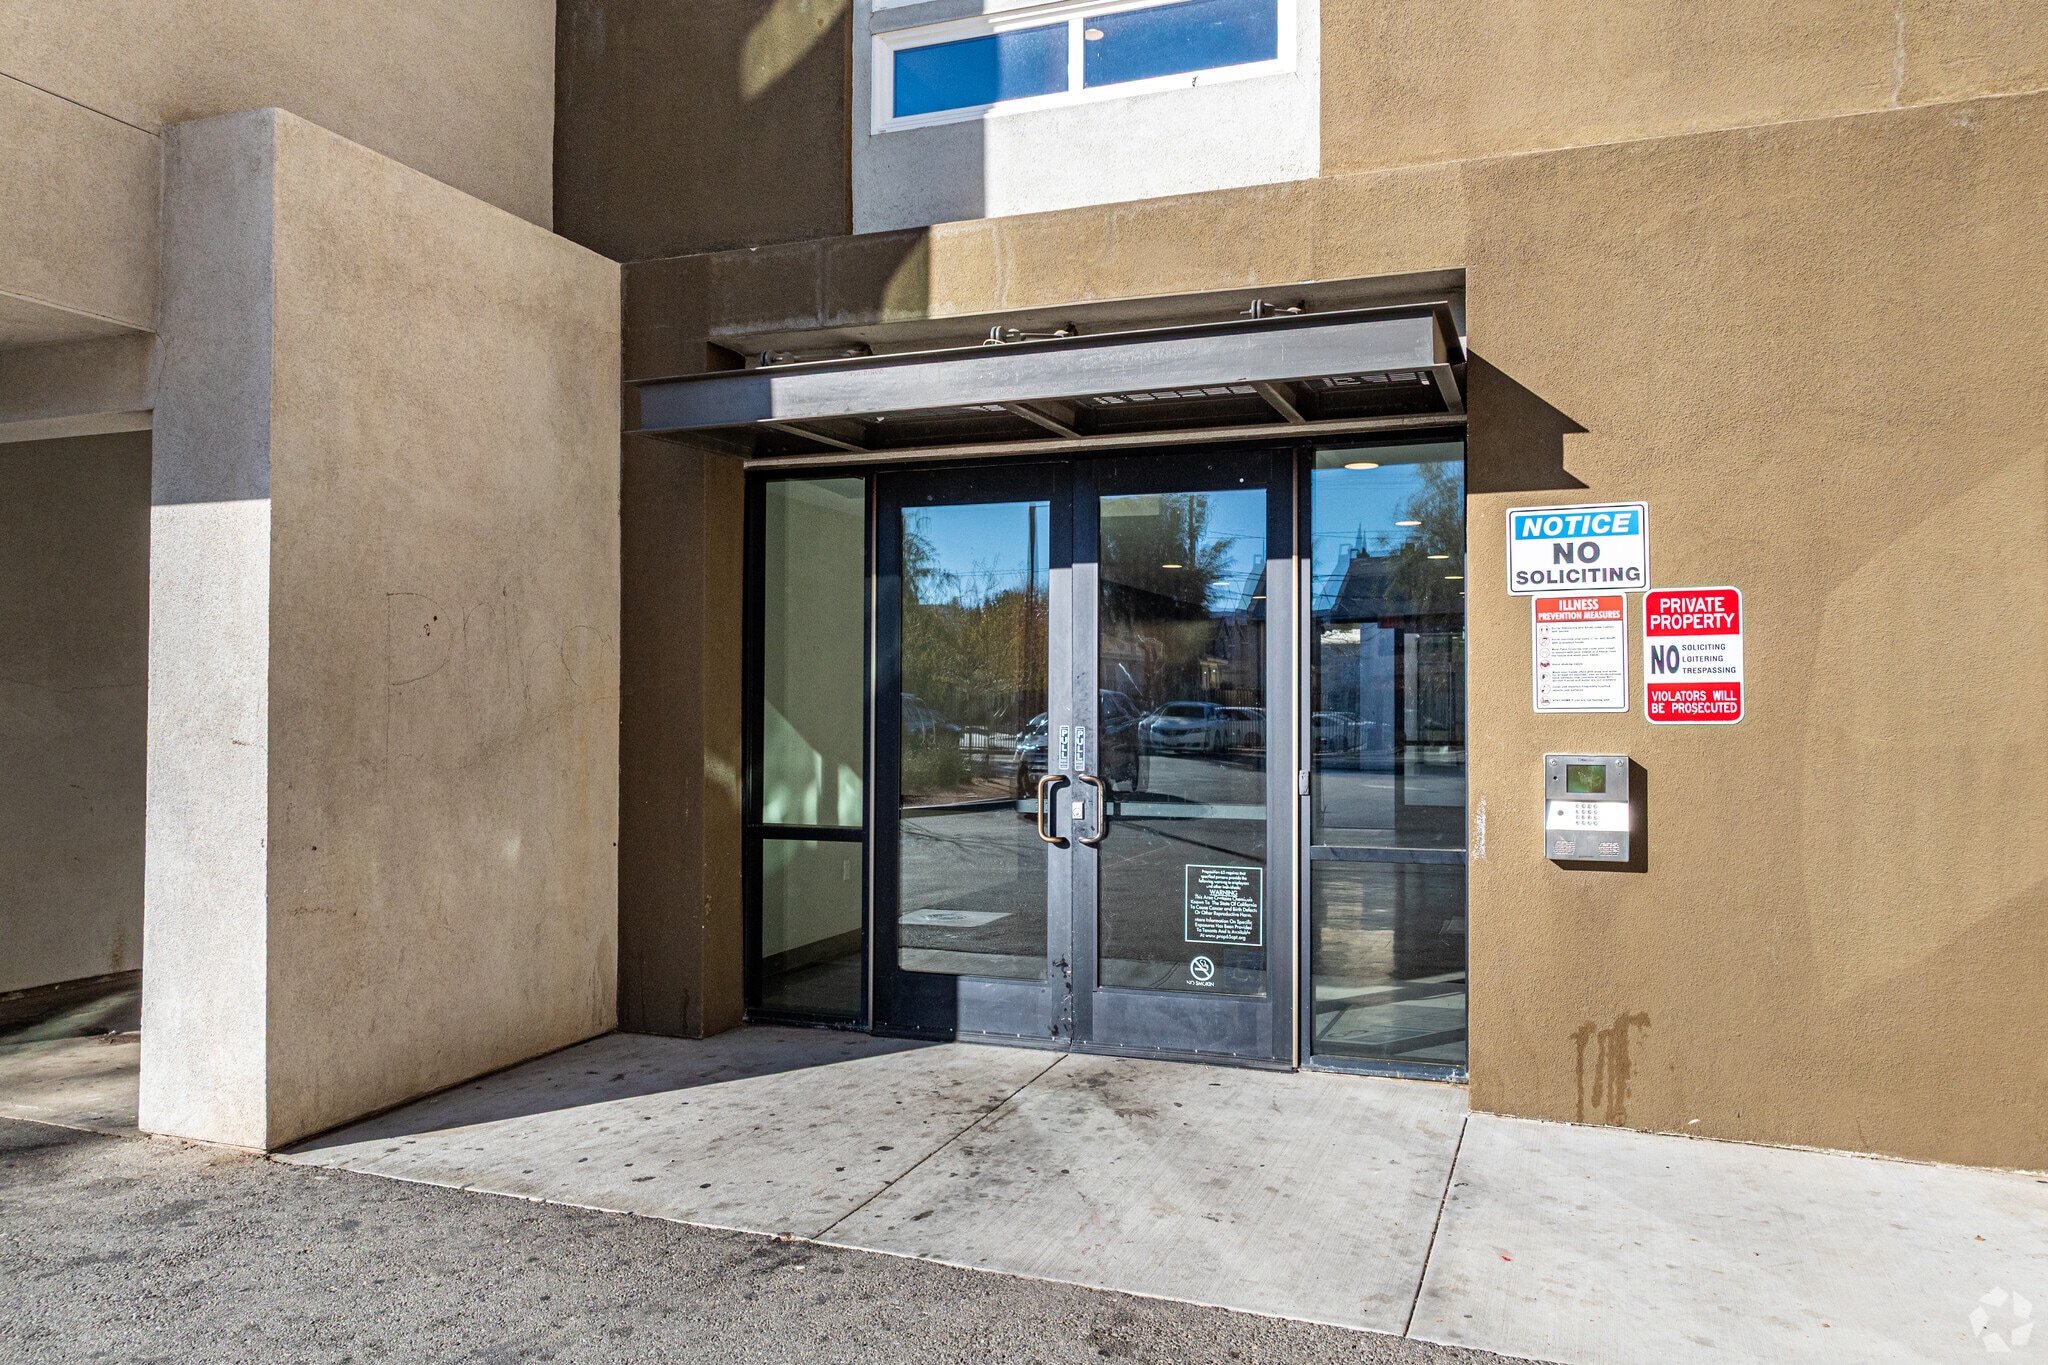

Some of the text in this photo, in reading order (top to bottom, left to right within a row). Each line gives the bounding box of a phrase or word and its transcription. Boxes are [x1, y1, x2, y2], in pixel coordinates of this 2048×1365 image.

[1522, 513, 1631, 537] NOTICE
[1553, 541, 1600, 564] NO
[1516, 567, 1640, 585] SOLICITING
[1559, 599, 1599, 611] ILLNESS
[1660, 597, 1725, 613] PRIVATE
[1538, 610, 1620, 620] PREVENTION MEASURES
[1650, 613, 1735, 630] PROPERTY
[1651, 645, 1680, 674] NO
[1682, 655, 1724, 663] LOITERING
[1651, 690, 1737, 702] VIOLATORS WILL
[1651, 702, 1738, 714] BE PROSECUTED
